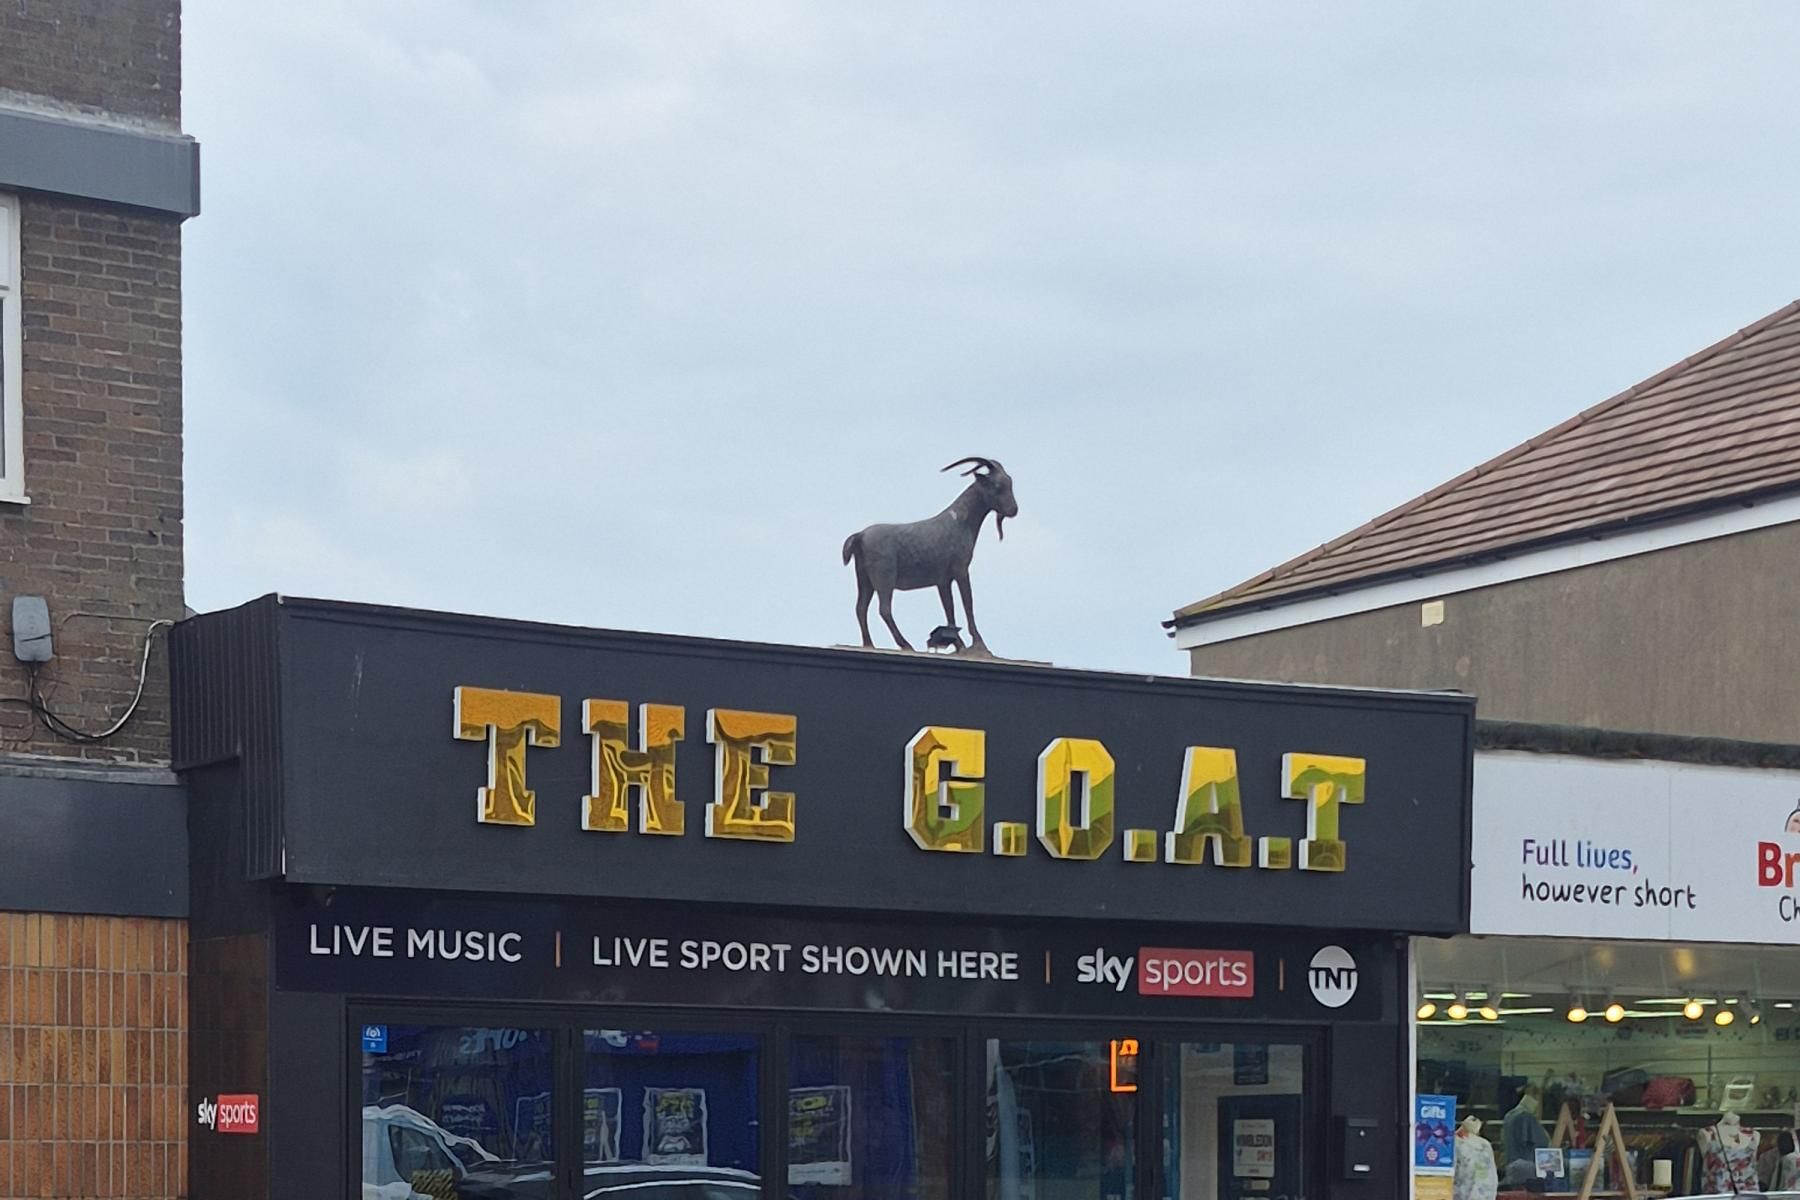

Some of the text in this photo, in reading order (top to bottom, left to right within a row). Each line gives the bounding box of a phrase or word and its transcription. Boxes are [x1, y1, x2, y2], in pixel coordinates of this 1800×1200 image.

[453, 685, 1366, 872] THE G.O.A.T
[1522, 839, 1638, 875] Full lives,
[1522, 872, 1697, 910] however short
[309, 924, 522, 963] LIVE MUSIC
[593, 936, 1019, 980] LIVE SPORT SHOWN HERE
[1076, 947, 1247, 992] sky sports
[197, 1097, 256, 1131] sky sports
